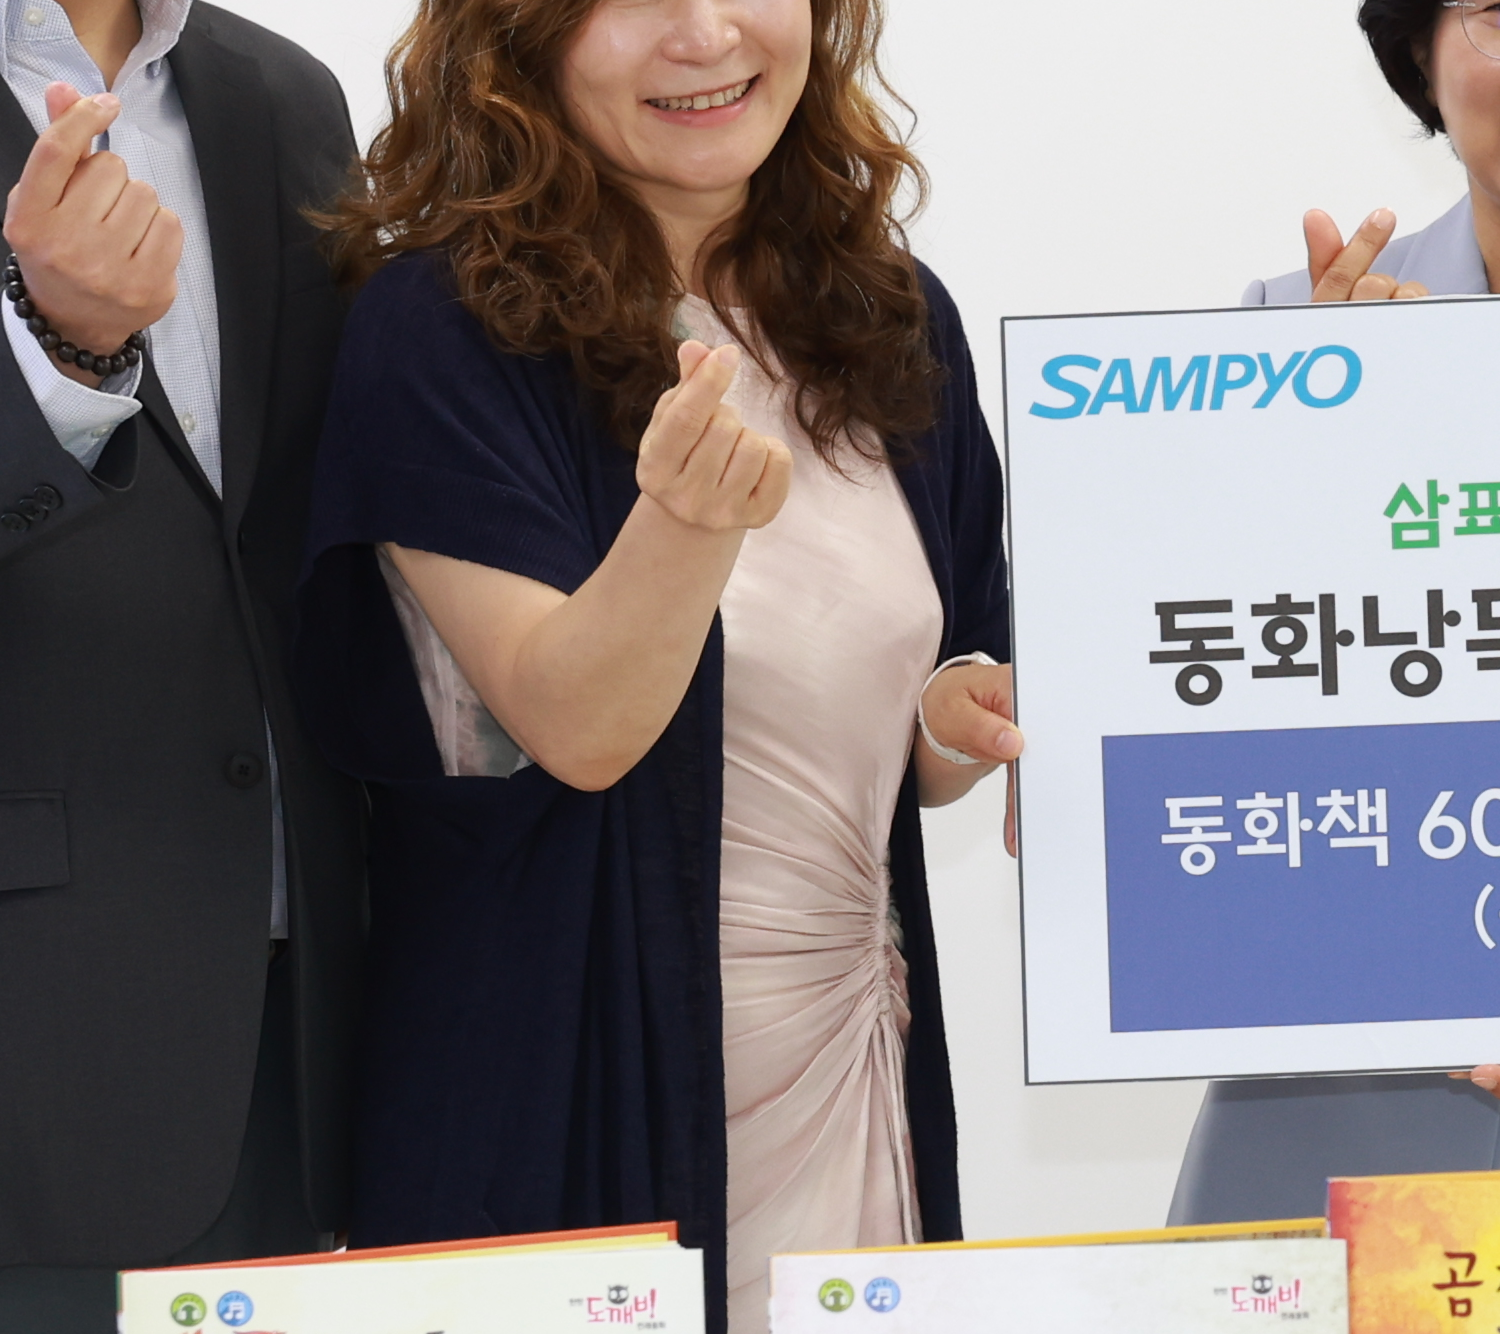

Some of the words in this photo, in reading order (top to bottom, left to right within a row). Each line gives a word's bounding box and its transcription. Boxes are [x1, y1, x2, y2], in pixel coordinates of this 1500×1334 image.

[1027, 344, 1364, 421] SAMPYO
[1160, 787, 1390, 877] 동화책
[1432, 1251, 1484, 1318] 곰
